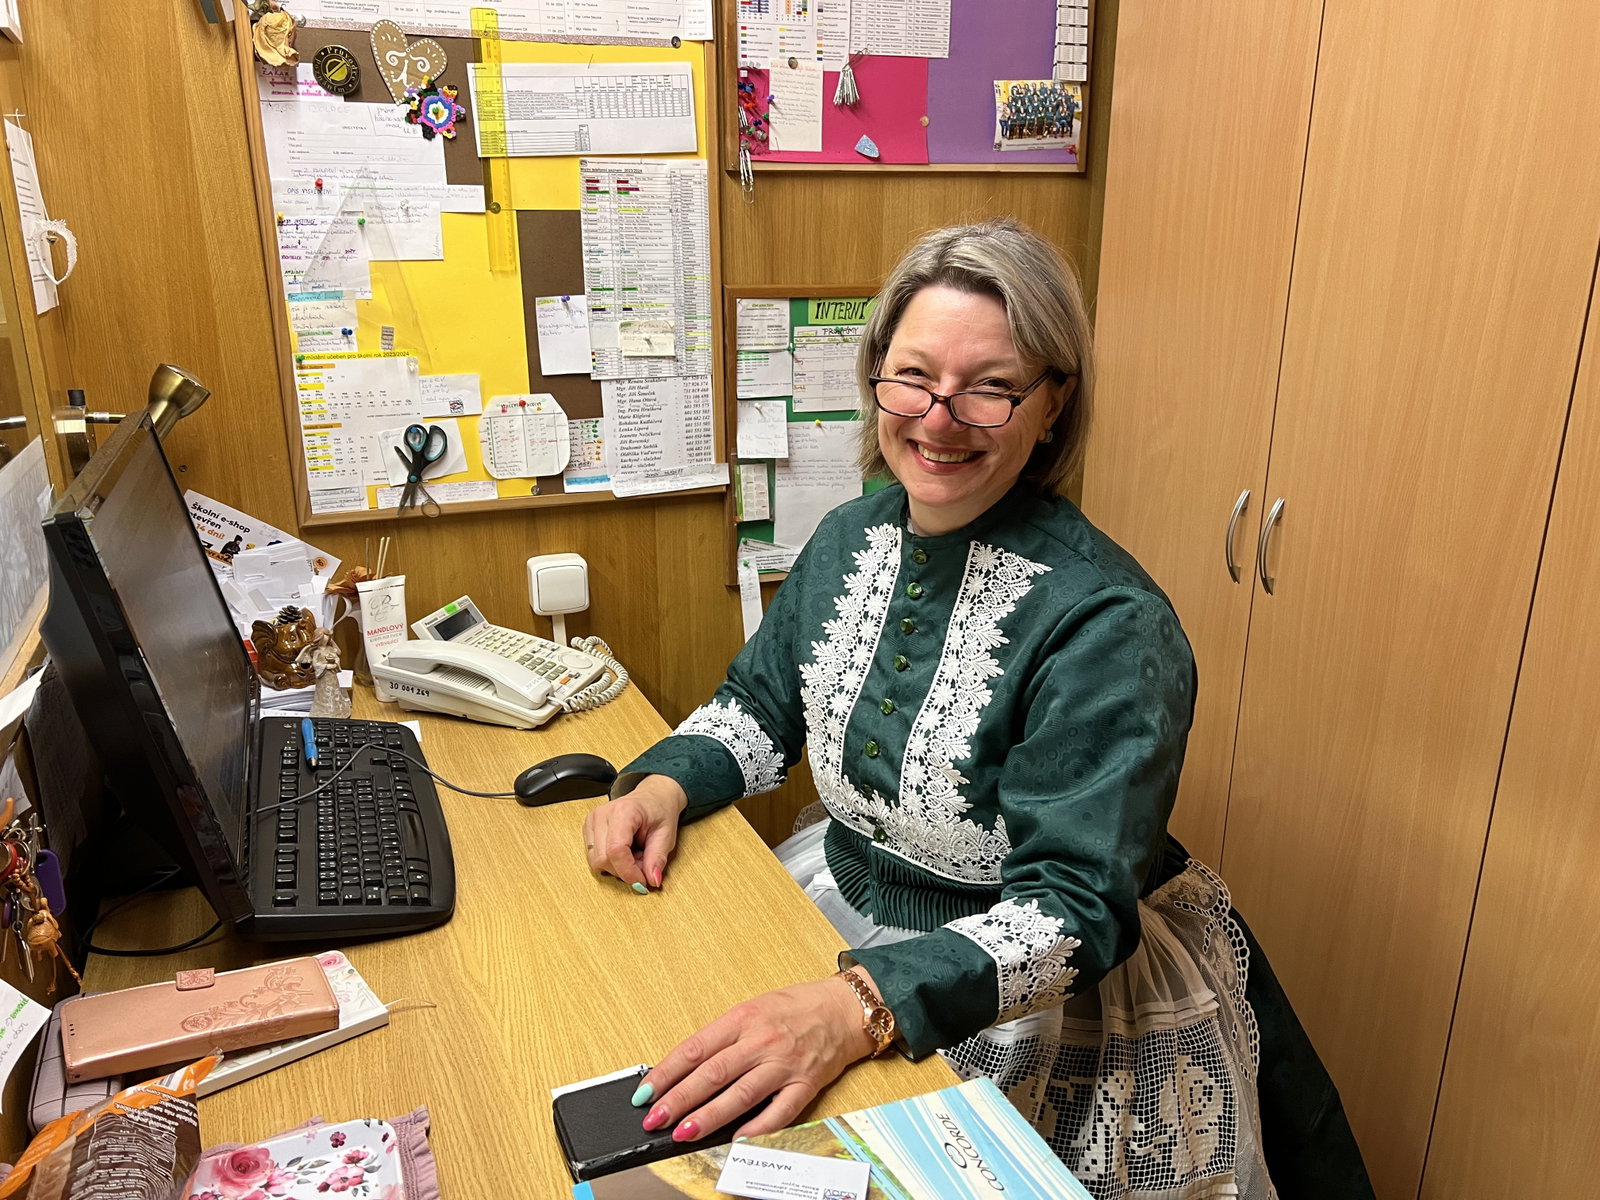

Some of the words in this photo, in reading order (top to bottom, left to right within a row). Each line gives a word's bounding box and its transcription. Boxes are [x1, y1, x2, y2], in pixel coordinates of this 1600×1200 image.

[191, 502, 221, 520] Školní
[220, 515, 251, 534] e-shop
[208, 528, 225, 540] dní!
[367, 623, 404, 636] MANDLOVÝ
[936, 1112, 1005, 1192] CONCORDE
[732, 1156, 792, 1170] NÁVŠTĚVA
